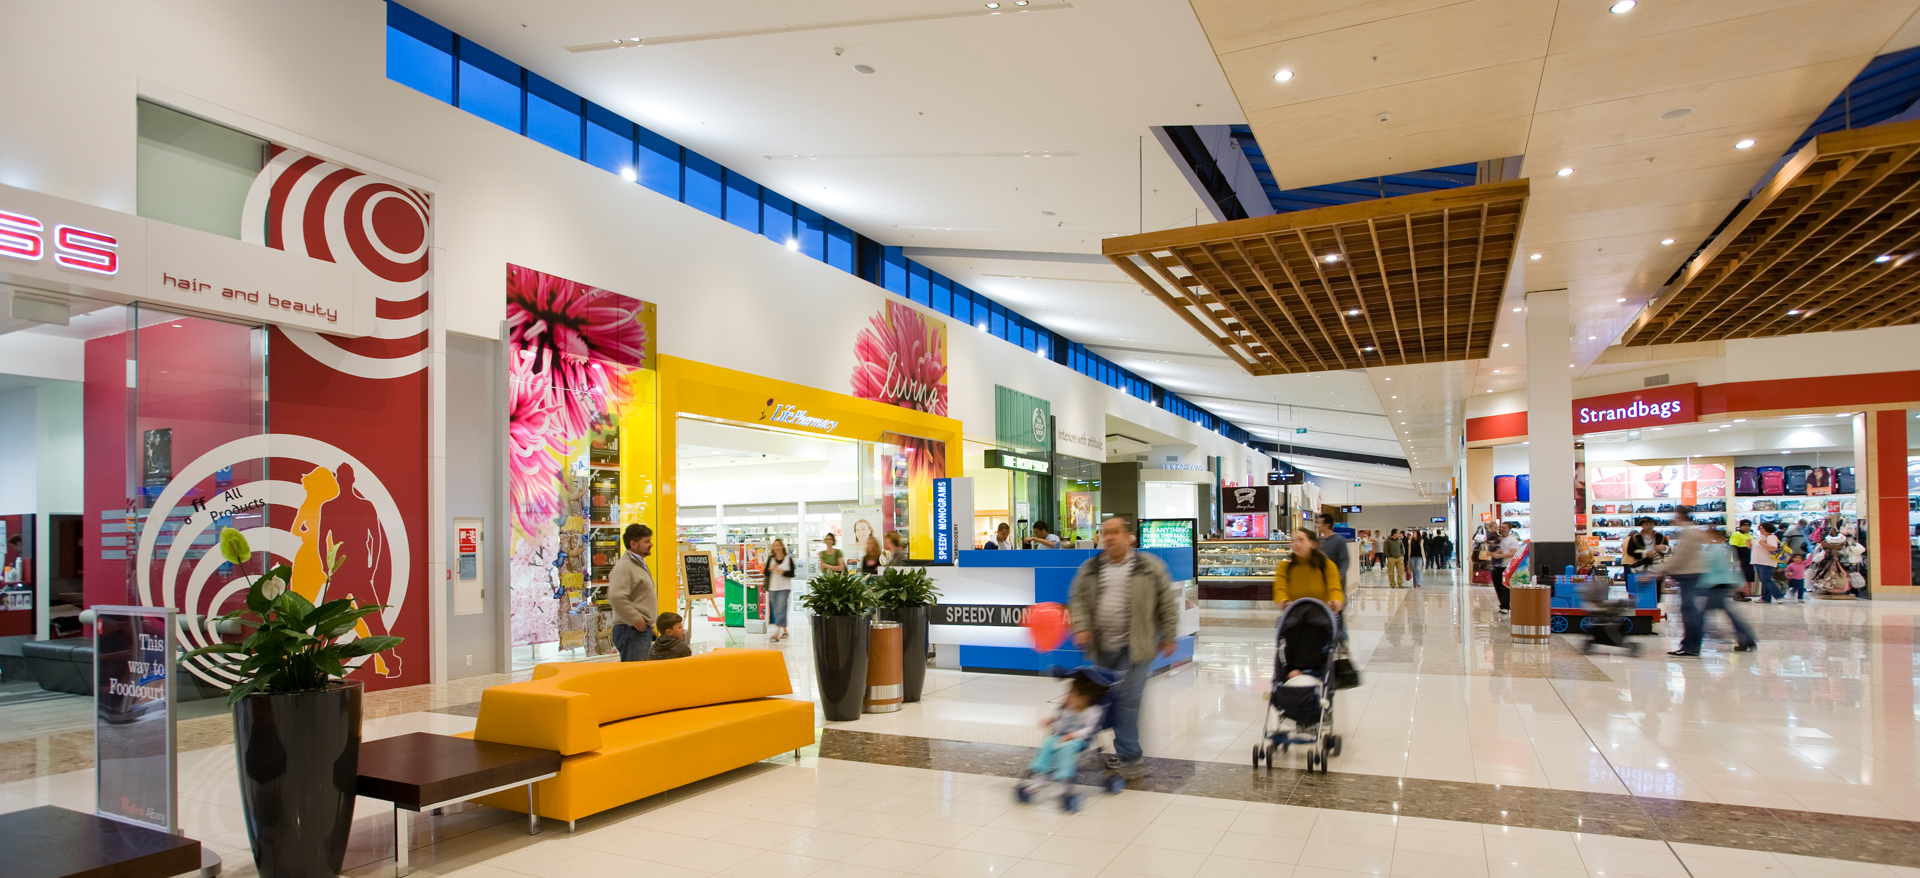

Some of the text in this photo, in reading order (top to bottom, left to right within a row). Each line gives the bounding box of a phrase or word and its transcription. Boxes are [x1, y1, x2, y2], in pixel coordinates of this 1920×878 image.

[163, 272, 337, 322] hair and beauty
[879, 351, 939, 415] living
[1580, 400, 1681, 424] Strandbags
[224, 487, 243, 502] All
[209, 498, 265, 523] Products
[938, 482, 947, 560] SPEEDY MONOGRAMS
[946, 606, 995, 624] SPEEDY
[139, 634, 164, 652] This
[128, 659, 165, 679] way to
[110, 678, 165, 700] Foodcourt
